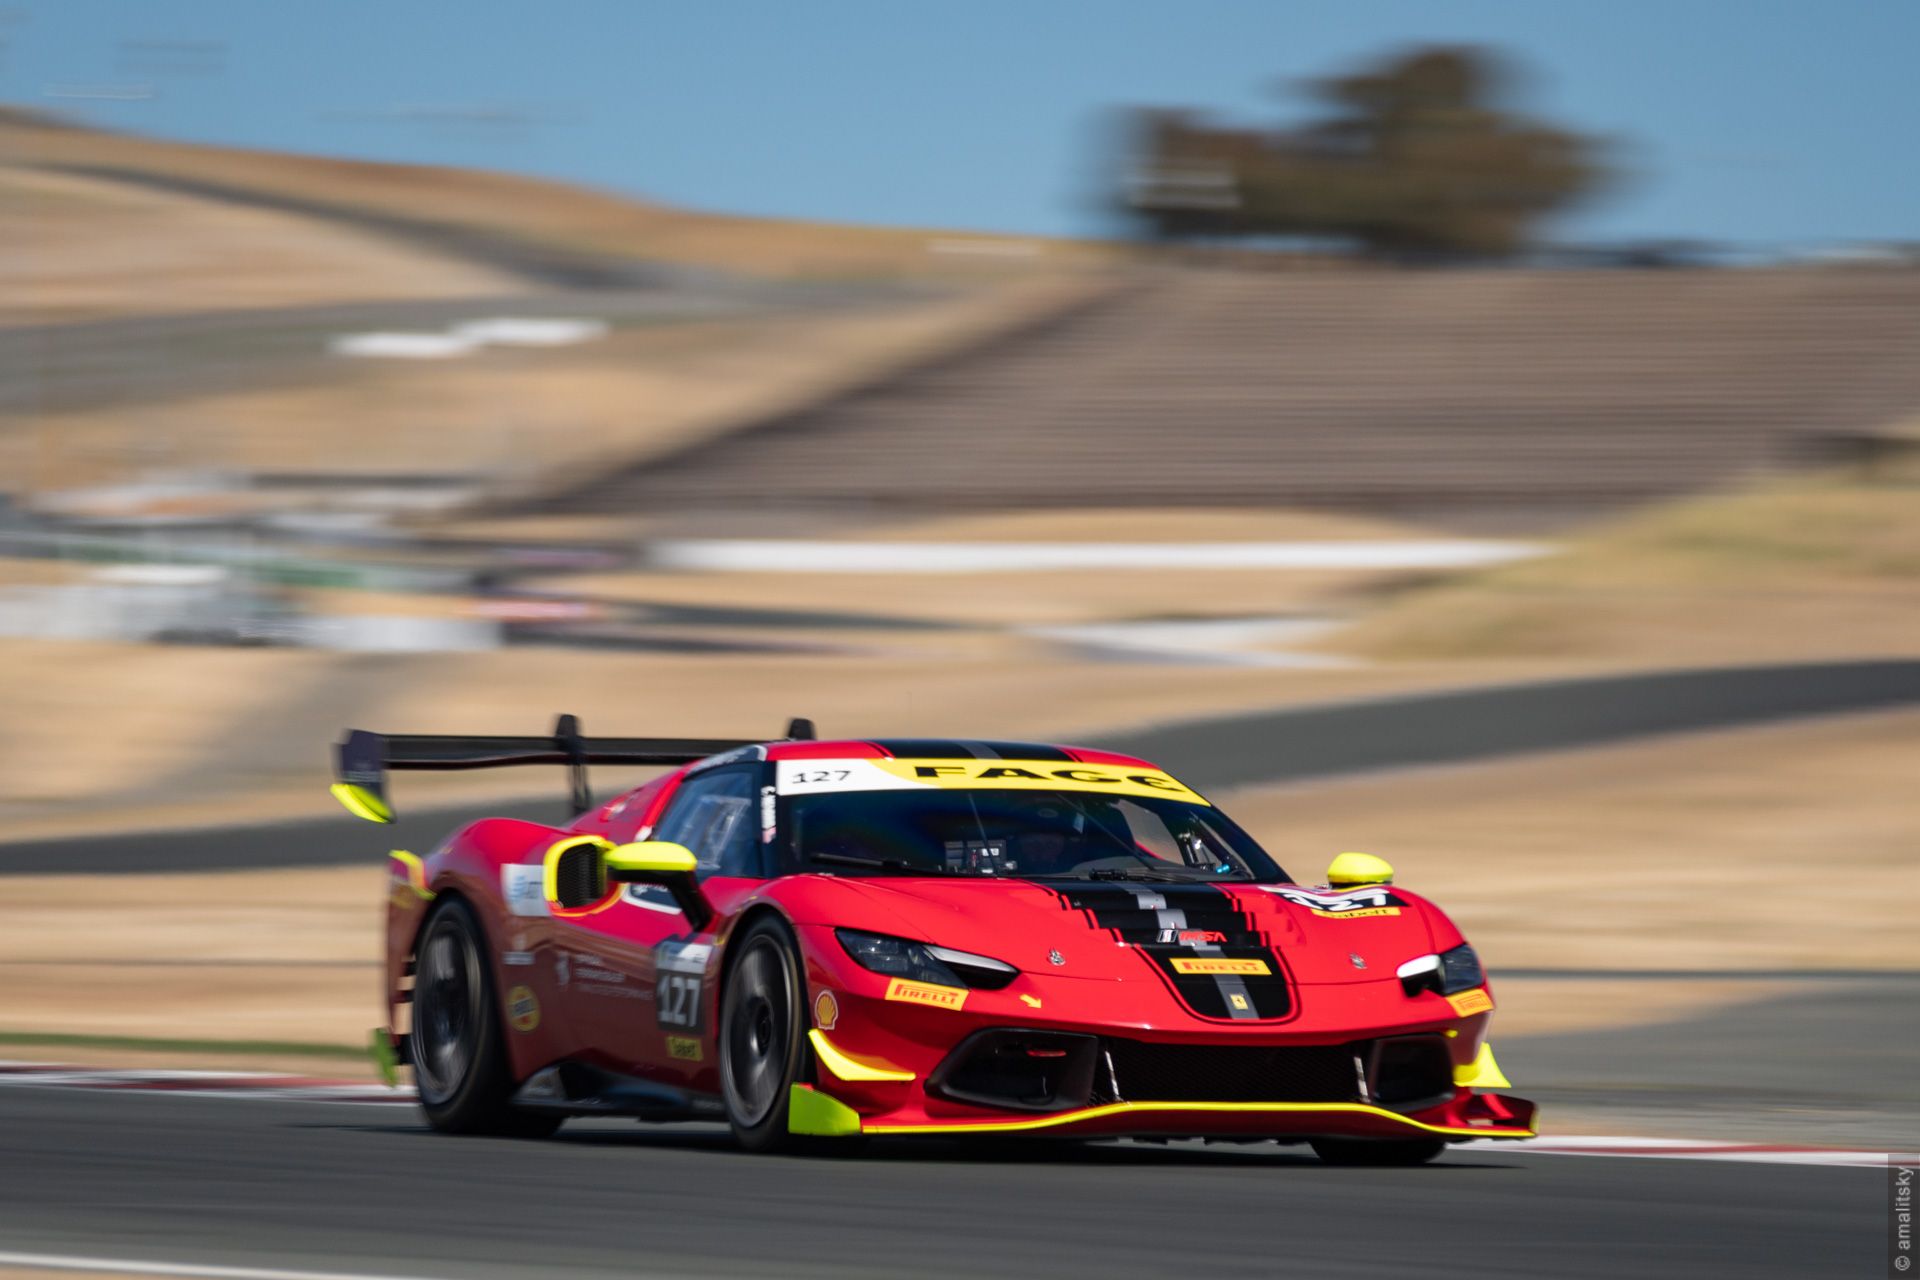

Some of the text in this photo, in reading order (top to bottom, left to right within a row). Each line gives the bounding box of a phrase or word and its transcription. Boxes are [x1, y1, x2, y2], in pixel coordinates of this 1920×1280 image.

[791, 770, 851, 784] 127
[913, 765, 1186, 792] FAGE
[1181, 961, 1260, 971] PIRELLI
[657, 975, 700, 1027] 127
[894, 983, 959, 1004] PIRELLI
